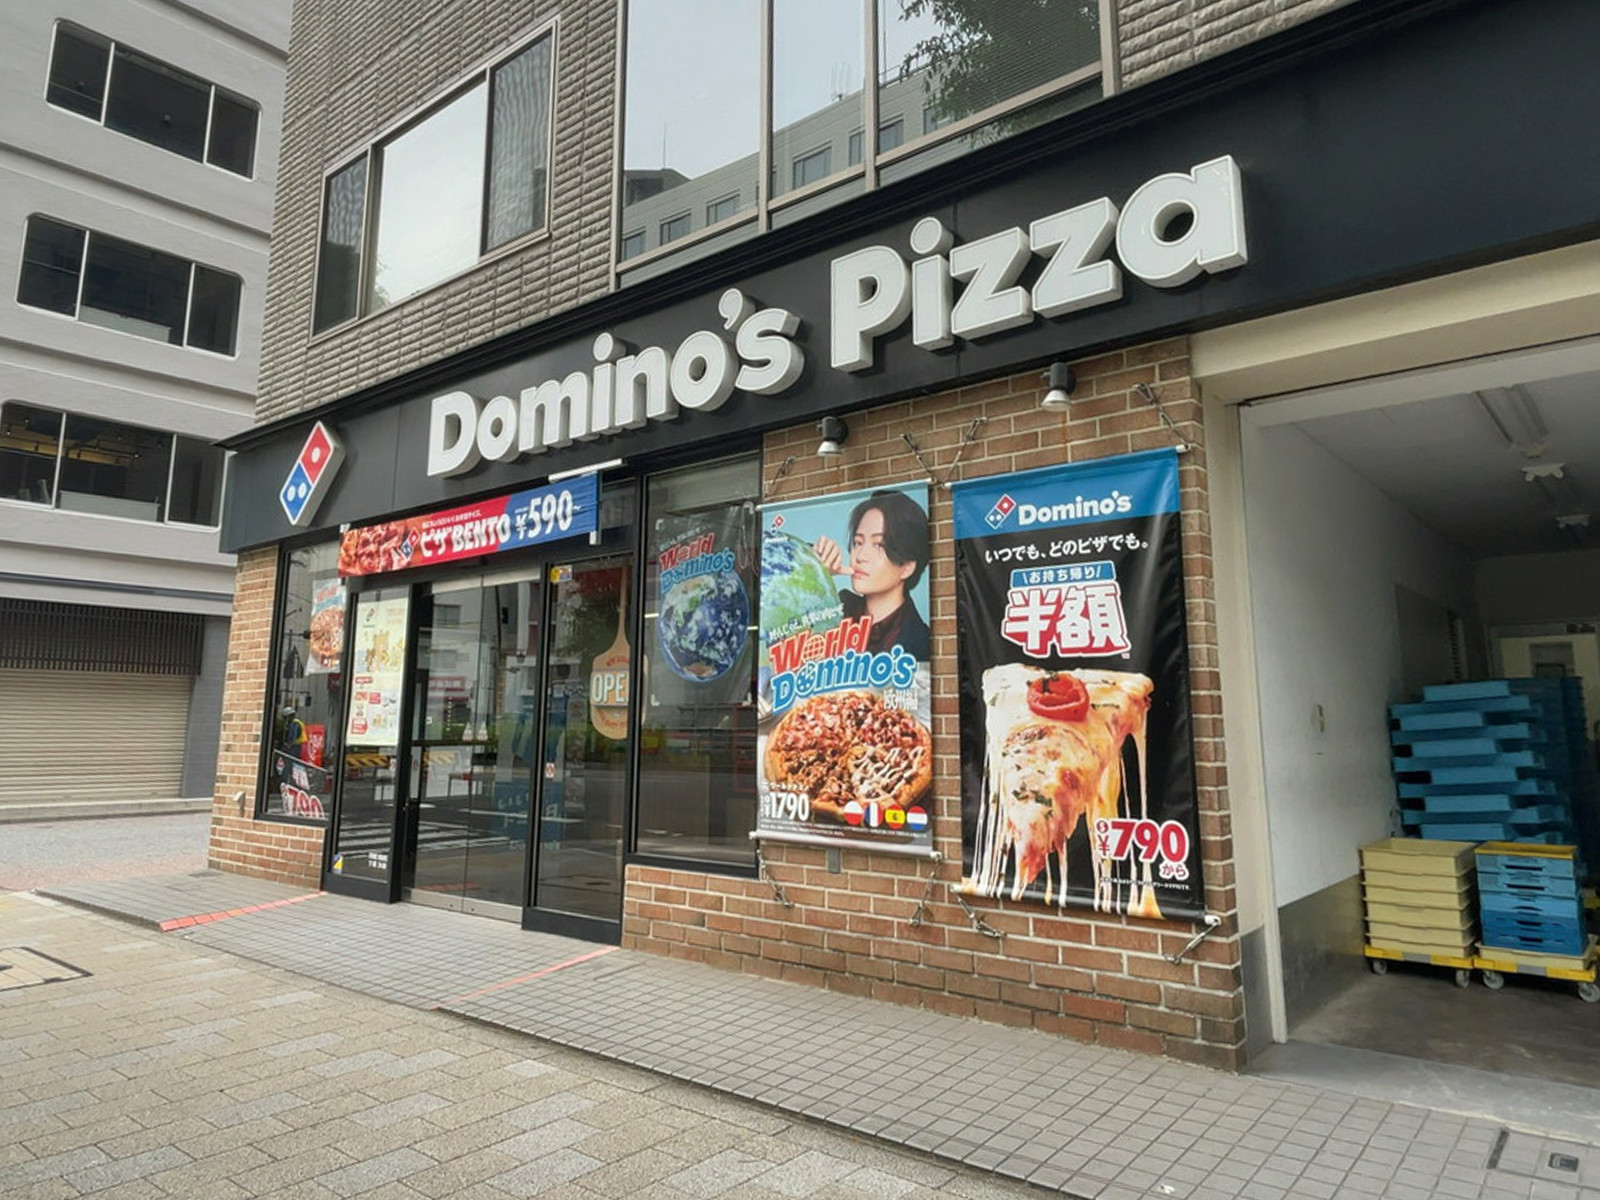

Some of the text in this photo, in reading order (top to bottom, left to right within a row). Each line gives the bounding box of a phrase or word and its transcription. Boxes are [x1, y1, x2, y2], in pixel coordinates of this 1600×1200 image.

[427, 155, 1249, 478] Domino's Pizza
[1018, 490, 1133, 526] Domino's
[660, 547, 735, 594] Domino's
[984, 532, 1149, 564] いつでも、どのピザでも。
[1003, 584, 1129, 653] 半額
[769, 615, 873, 674] World
[592, 673, 629, 704] OPE
[771, 645, 917, 715] Domino's
[1160, 863, 1188, 879] から
